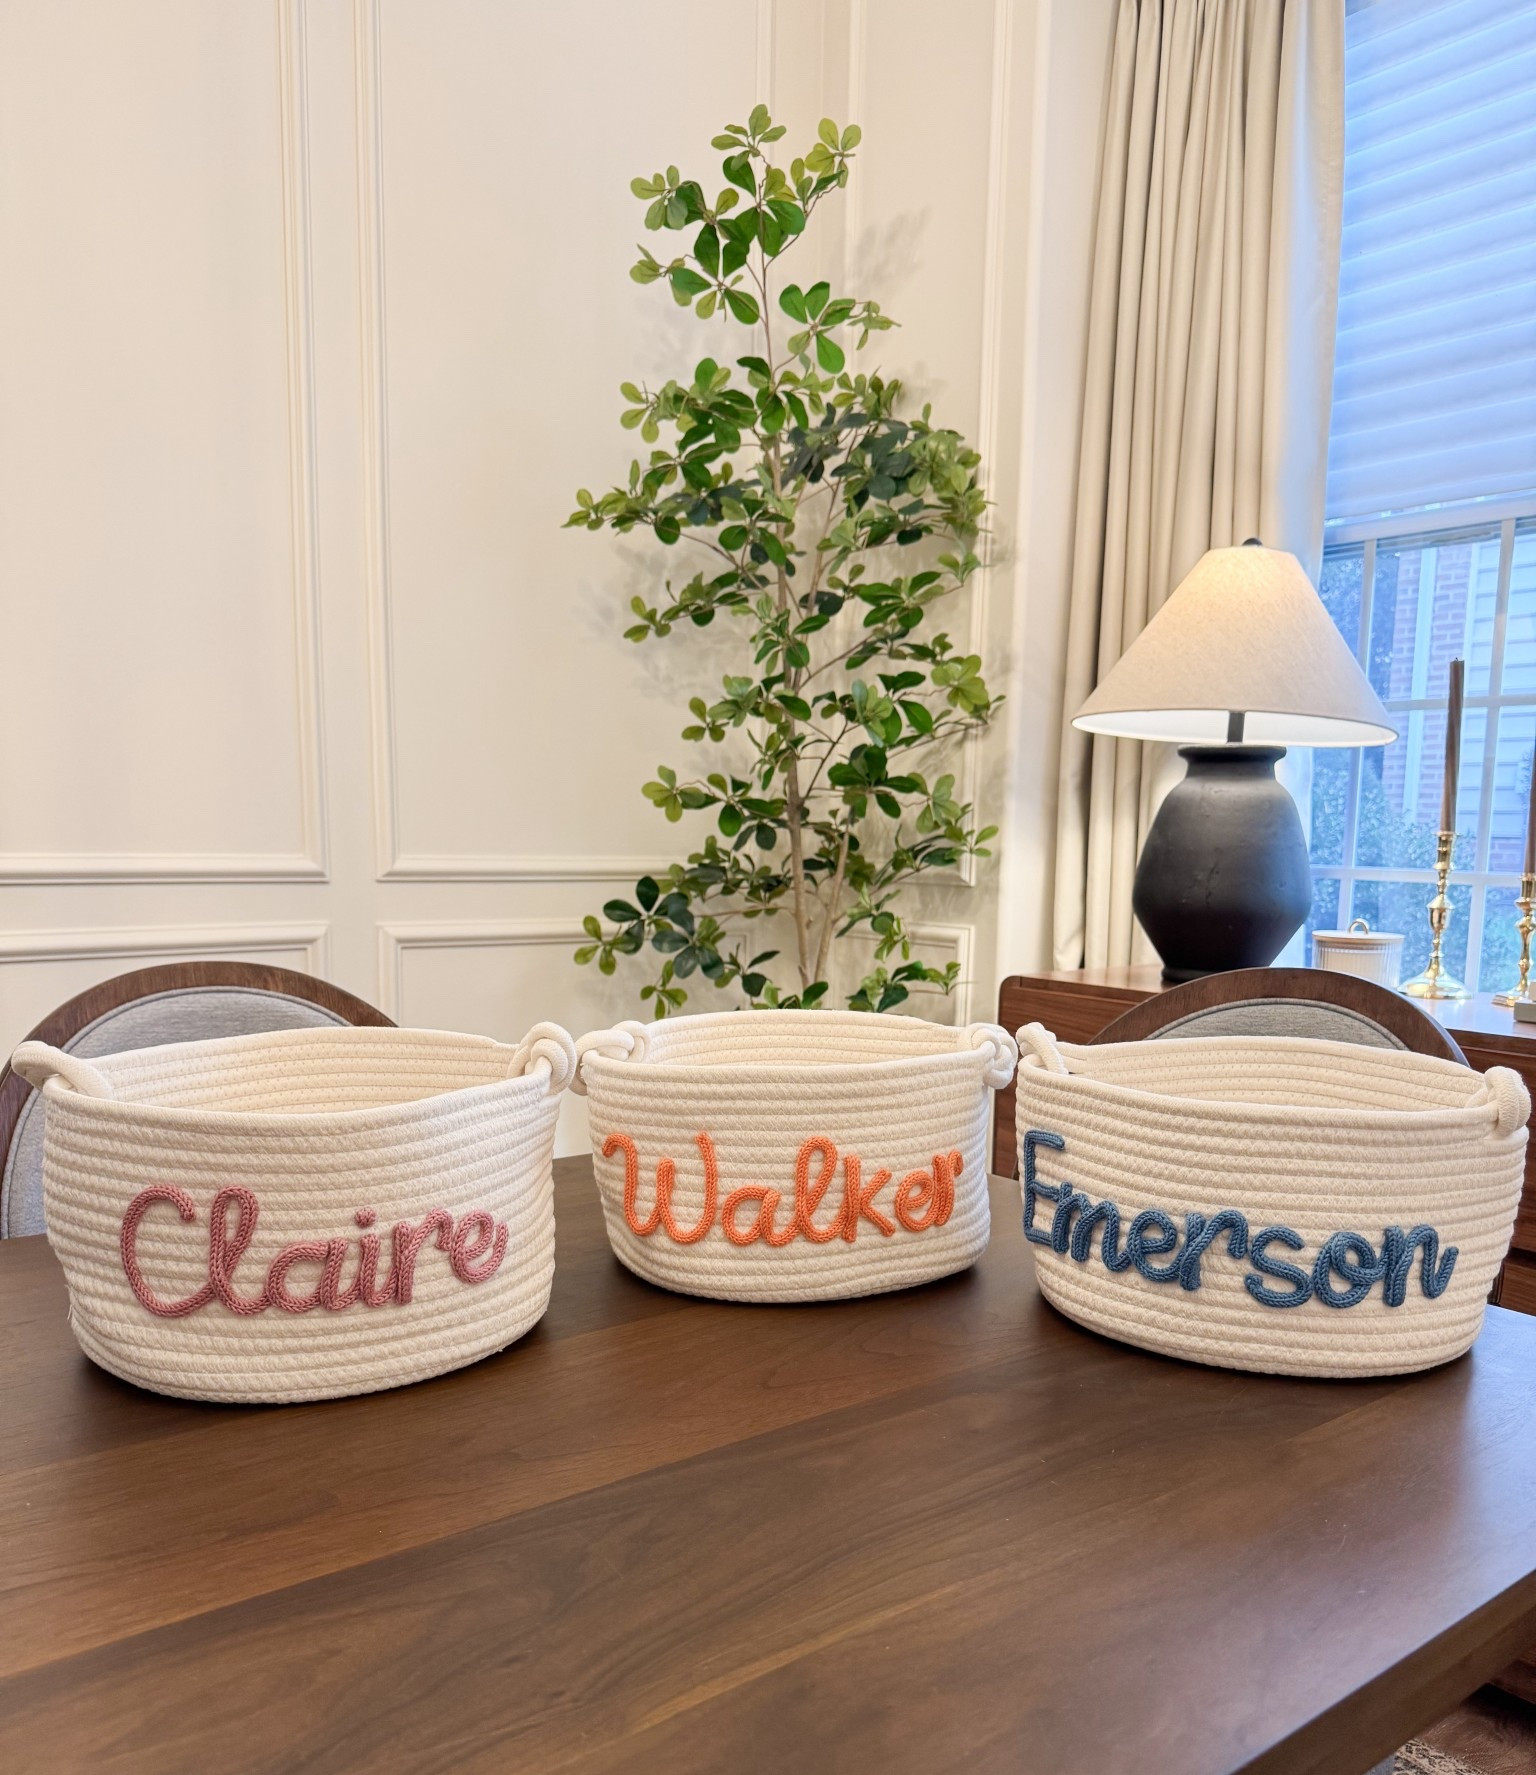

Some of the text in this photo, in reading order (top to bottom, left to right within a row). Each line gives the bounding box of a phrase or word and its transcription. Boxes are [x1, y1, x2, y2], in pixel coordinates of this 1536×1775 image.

[121, 1186, 507, 1317] Claire
[603, 1133, 963, 1246] Walker
[1023, 1131, 1458, 1308] Emerson
